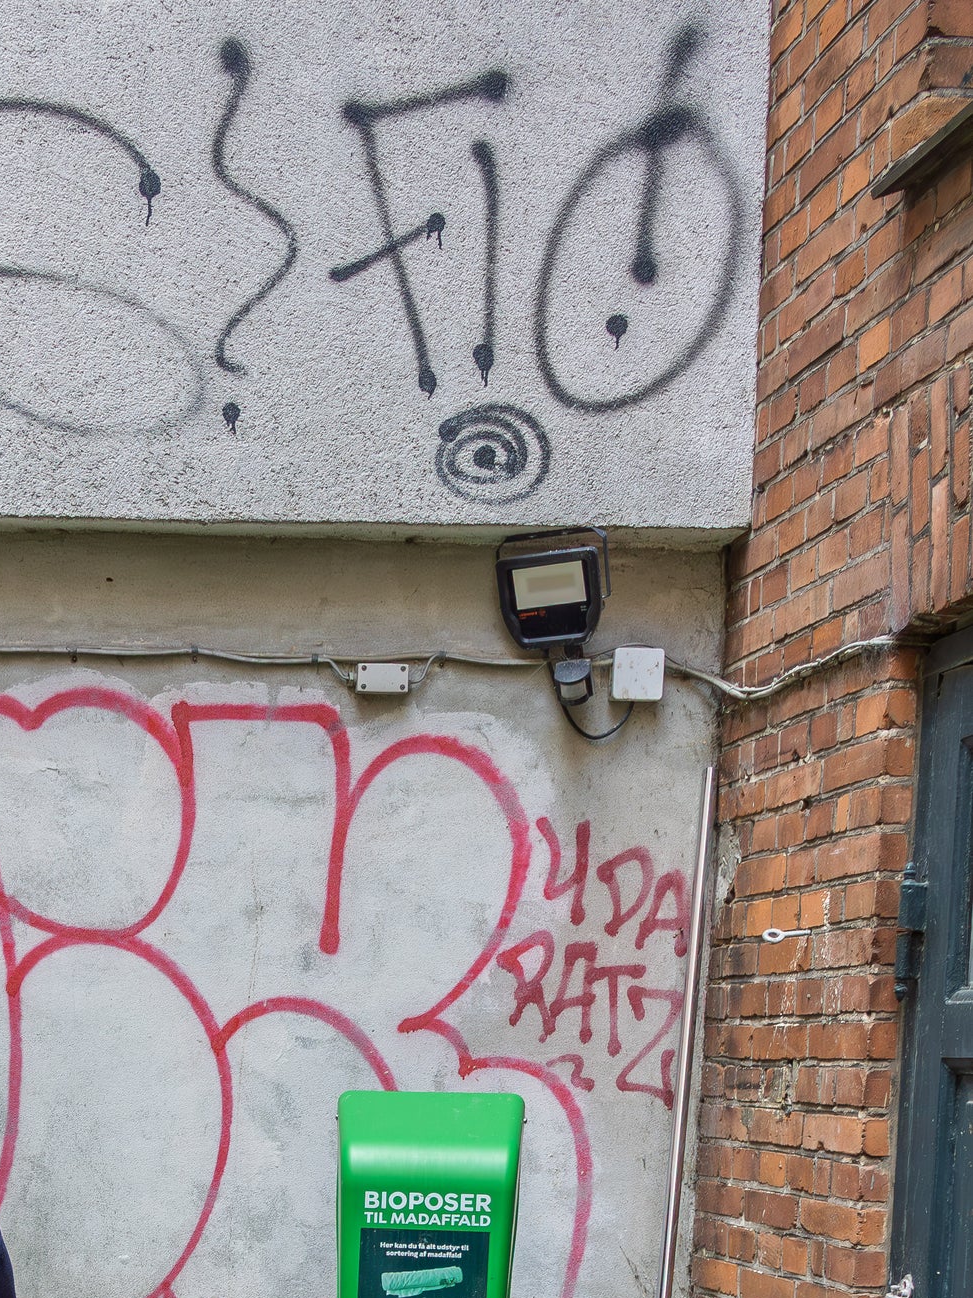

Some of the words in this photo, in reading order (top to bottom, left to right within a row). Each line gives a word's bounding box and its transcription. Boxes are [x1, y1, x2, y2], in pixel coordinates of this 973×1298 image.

[364, 1190, 491, 1212] BIOPOSER
[364, 1211, 388, 1224] TIL
[390, 1212, 491, 1227] MADAFFALD
[418, 1242, 426, 1250] få
[437, 1244, 460, 1252] udstyr
[386, 1250, 419, 1259] sortering
[419, 1250, 427, 1258] af
[427, 1251, 462, 1259] madaffald
